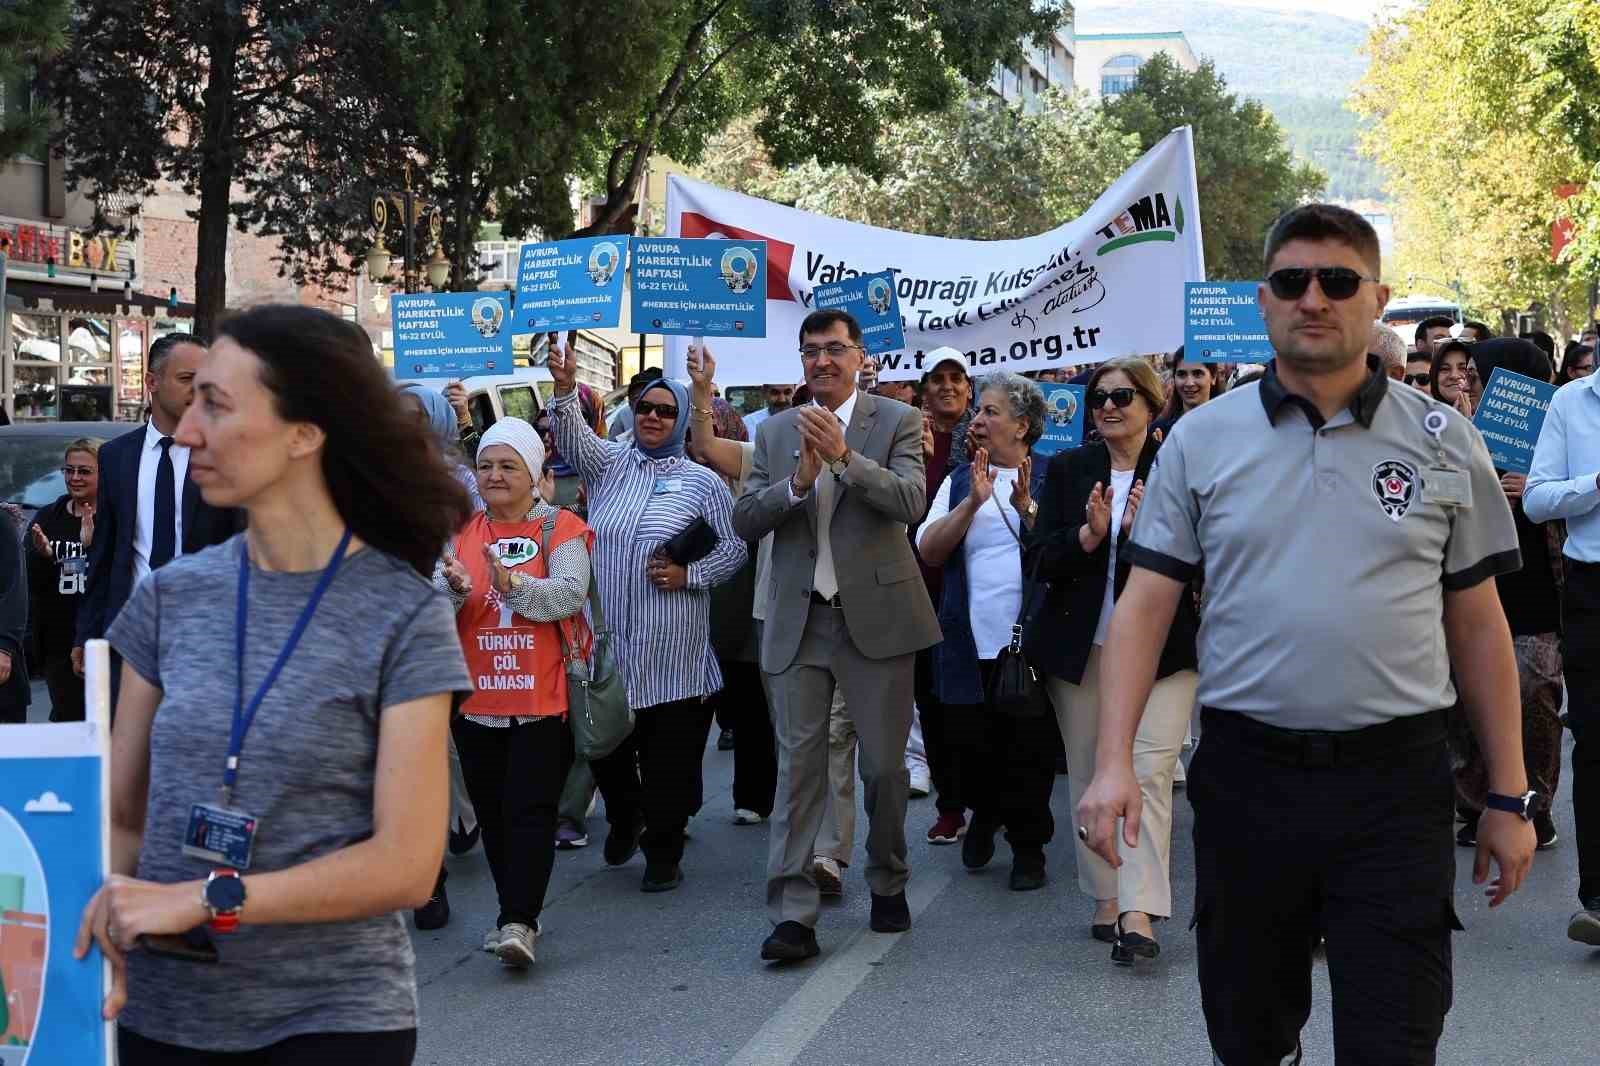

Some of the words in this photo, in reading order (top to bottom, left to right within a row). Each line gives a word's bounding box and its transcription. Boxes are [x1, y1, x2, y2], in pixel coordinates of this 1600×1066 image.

[1096, 193, 1172, 240] TEMA
[68, 230, 121, 272] BOX
[525, 247, 559, 258] AVRUPA
[637, 244, 680, 254] AVRUPA
[524, 254, 583, 270] HAREKETLİLİK
[637, 255, 712, 267] HAREKETLİLİK
[522, 270, 558, 281] HAFTASI
[637, 269, 682, 279] HAFTASI
[539, 281, 561, 292] EYLÜL
[637, 282, 660, 290] 16-22
[661, 280, 689, 291] EYLÜL
[1190, 287, 1227, 295] AVRUPA
[398, 299, 437, 308] AVRUPA
[1190, 295, 1255, 305] HAREKETLİLİK
[641, 301, 679, 309] #HERKES
[680, 300, 697, 312] İÇİN
[698, 302, 755, 312] HAREKETLİLİK
[1190, 307, 1229, 316] HAFTASI
[398, 307, 465, 319] HAREKETLİLİK
[398, 321, 439, 330] HAFTASI
[1210, 317, 1235, 326] EYLÜL
[420, 331, 446, 340] EYLÜL
[1495, 375, 1537, 395] AVRUPA
[1487, 398, 1529, 418] HAFTASI
[1503, 416, 1529, 432] EYLÜL
[499, 542, 525, 556] TEMA
[477, 630, 535, 650] TÜRKİYE
[493, 651, 521, 674] ÇÖL
[478, 674, 535, 690] OLMASIN
